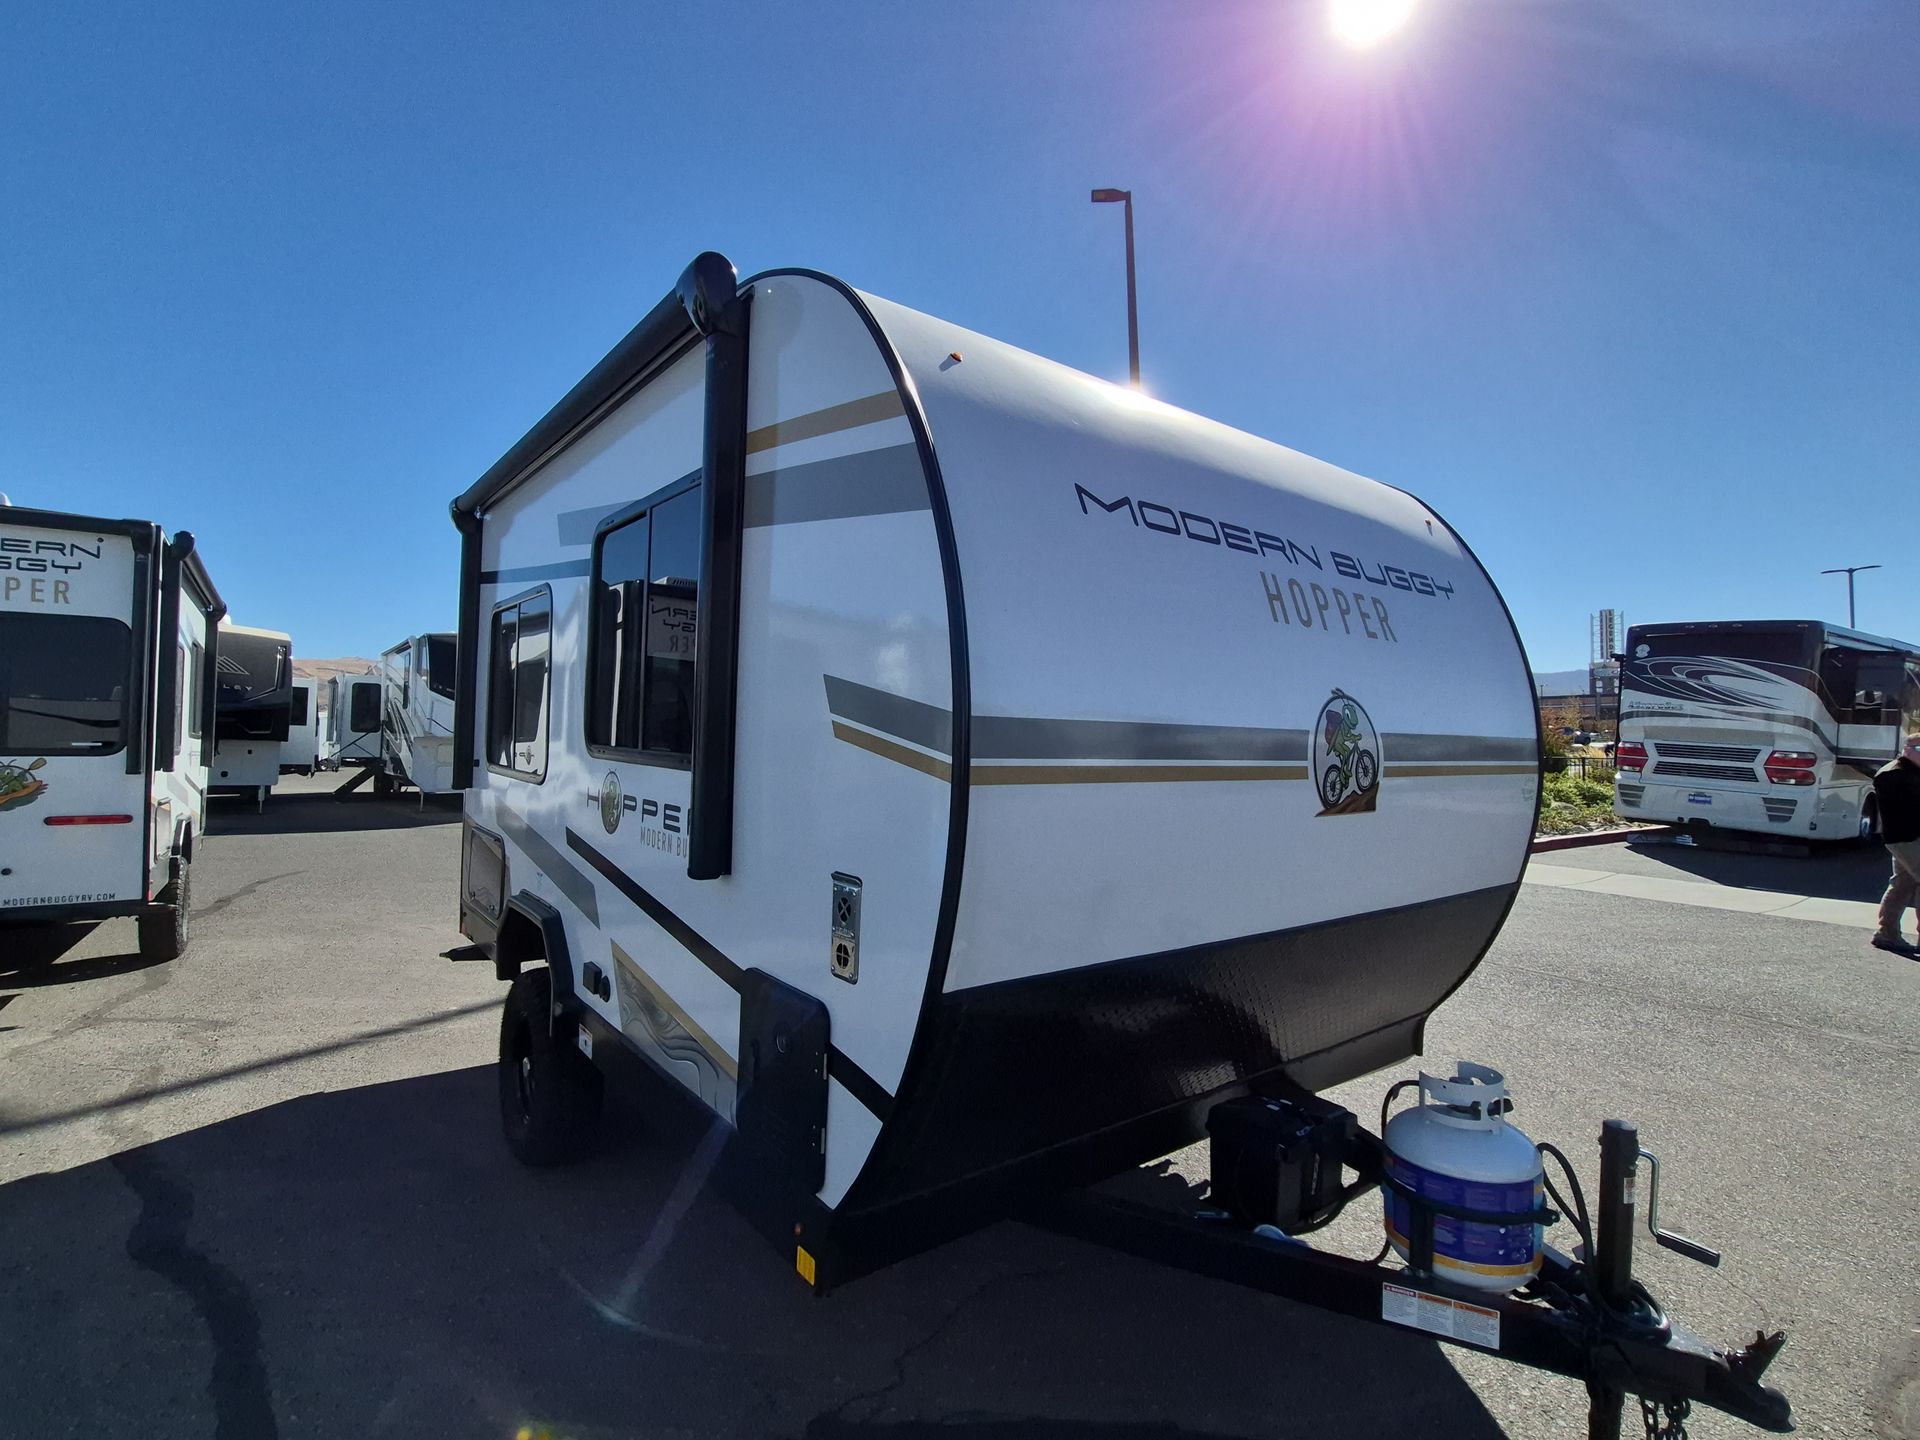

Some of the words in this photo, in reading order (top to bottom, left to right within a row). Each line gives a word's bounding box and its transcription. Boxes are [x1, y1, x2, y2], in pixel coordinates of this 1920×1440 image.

[1074, 482, 1323, 571] MODERN
[1329, 550, 1455, 600] BUGGY
[4, 576, 71, 604] PER
[1259, 570, 1399, 643] HOPPER
[640, 826, 673, 854] MODERN
[3, 893, 116, 906] MODERNBUGGYRV.COM
